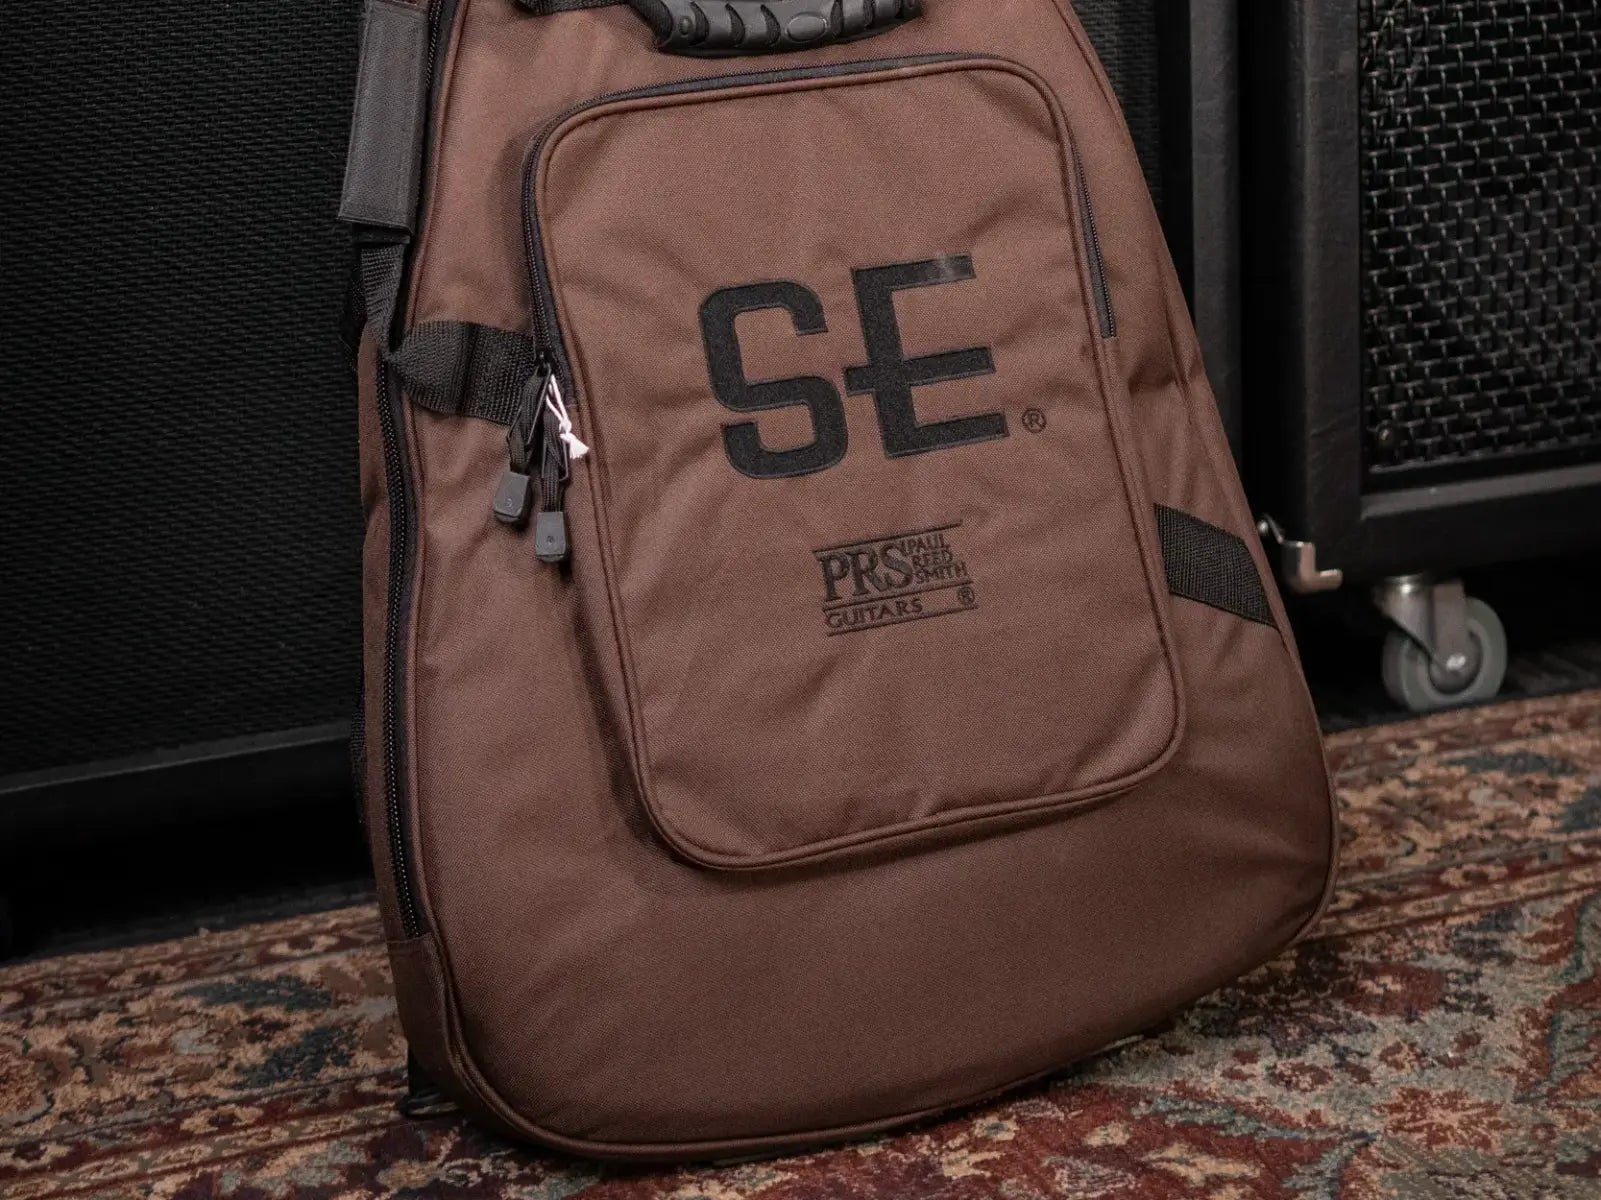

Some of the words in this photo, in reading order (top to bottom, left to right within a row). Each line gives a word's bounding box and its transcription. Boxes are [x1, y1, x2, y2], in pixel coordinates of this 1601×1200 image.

[698, 252, 1010, 480] SE
[817, 544, 914, 602] PRS
[825, 598, 923, 629] GUITARS
